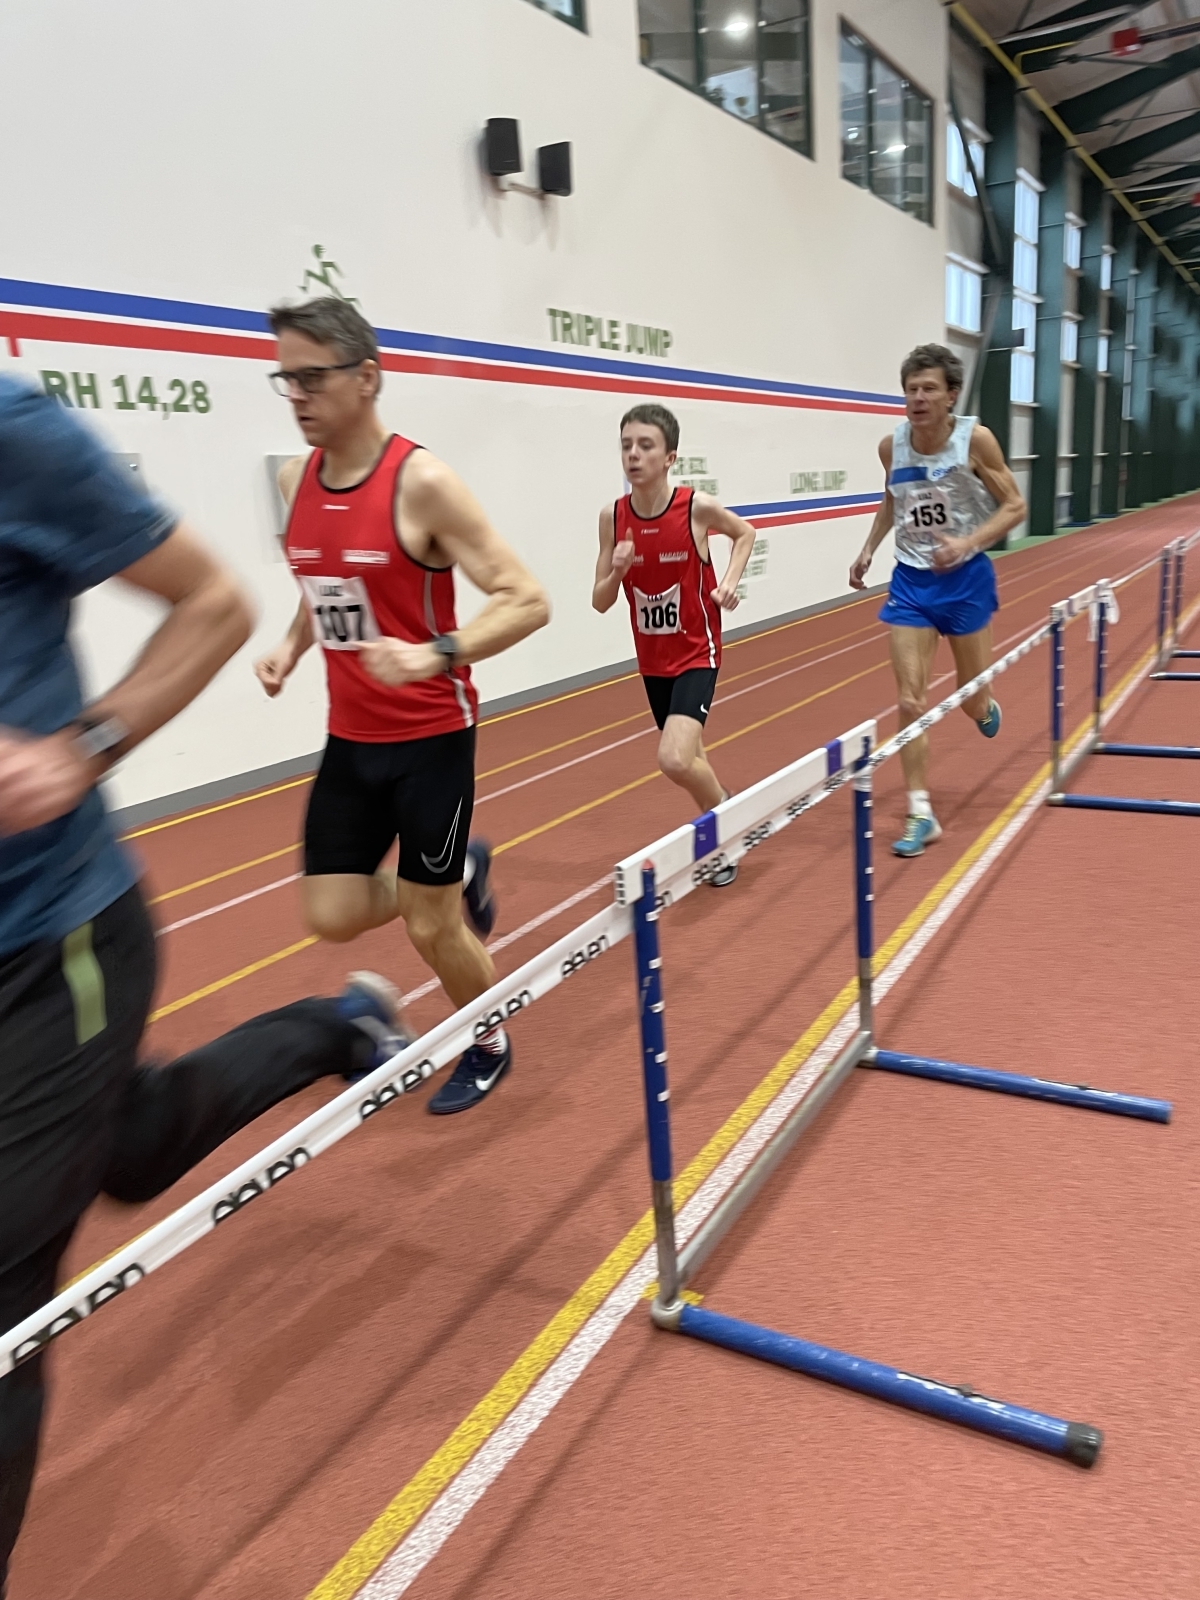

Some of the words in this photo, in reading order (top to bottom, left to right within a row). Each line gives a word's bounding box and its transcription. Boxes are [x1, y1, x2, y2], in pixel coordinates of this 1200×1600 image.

[546, 307, 621, 351] TRIPLE
[624, 322, 673, 358] JUMP
[112, 374, 211, 420] 14,28
[910, 503, 947, 527] 153
[640, 602, 678, 629] 106
[474, 989, 534, 1041] eleven
[360, 1058, 436, 1122] eleven
